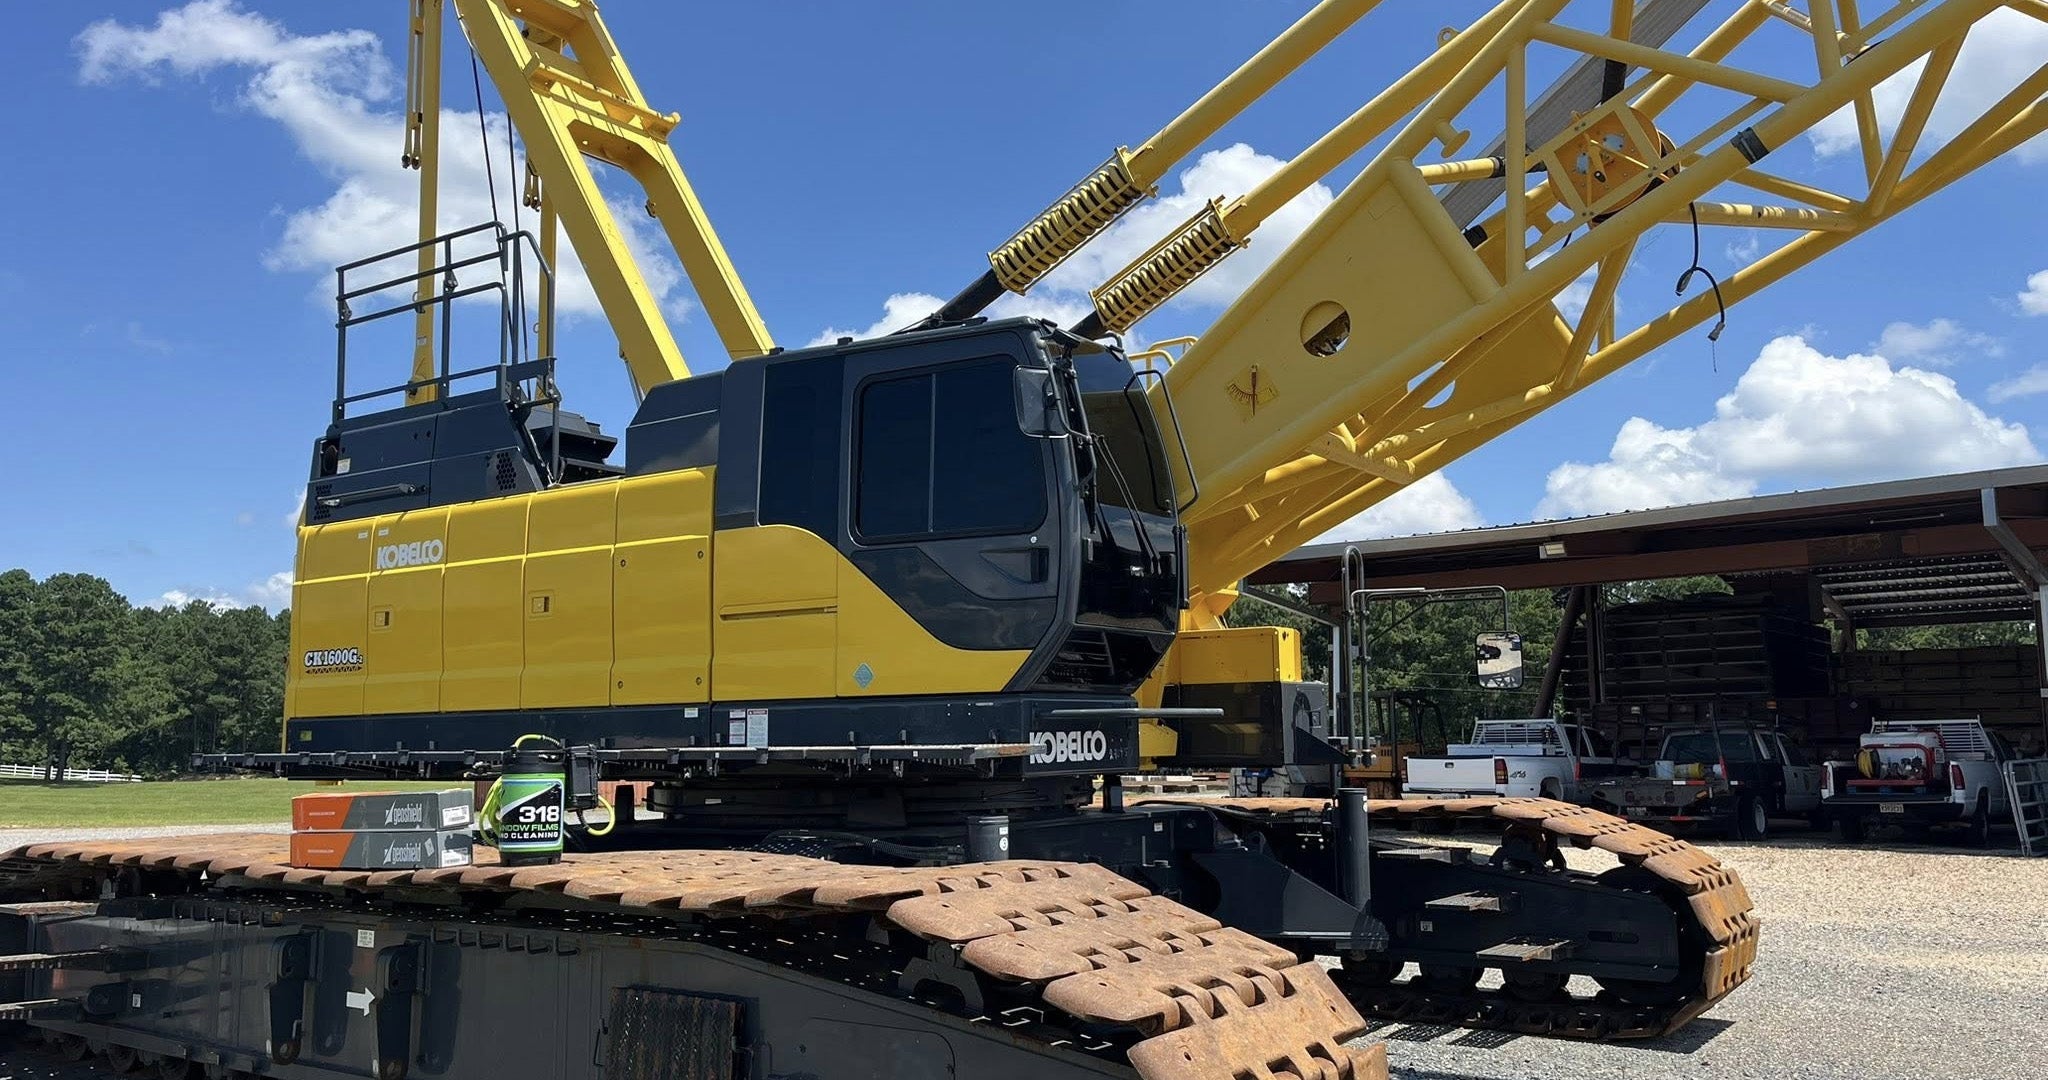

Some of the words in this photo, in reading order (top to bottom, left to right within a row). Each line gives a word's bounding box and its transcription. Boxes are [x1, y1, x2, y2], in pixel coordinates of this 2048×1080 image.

[376, 538, 444, 570] KOBELCO
[1029, 729, 1107, 764] KOBELCO
[393, 803, 422, 826] geoshield
[518, 805, 560, 823] 318
[510, 831, 559, 840] CLEANING
[531, 823, 559, 832] FILMS
[392, 842, 422, 864] geoshield
